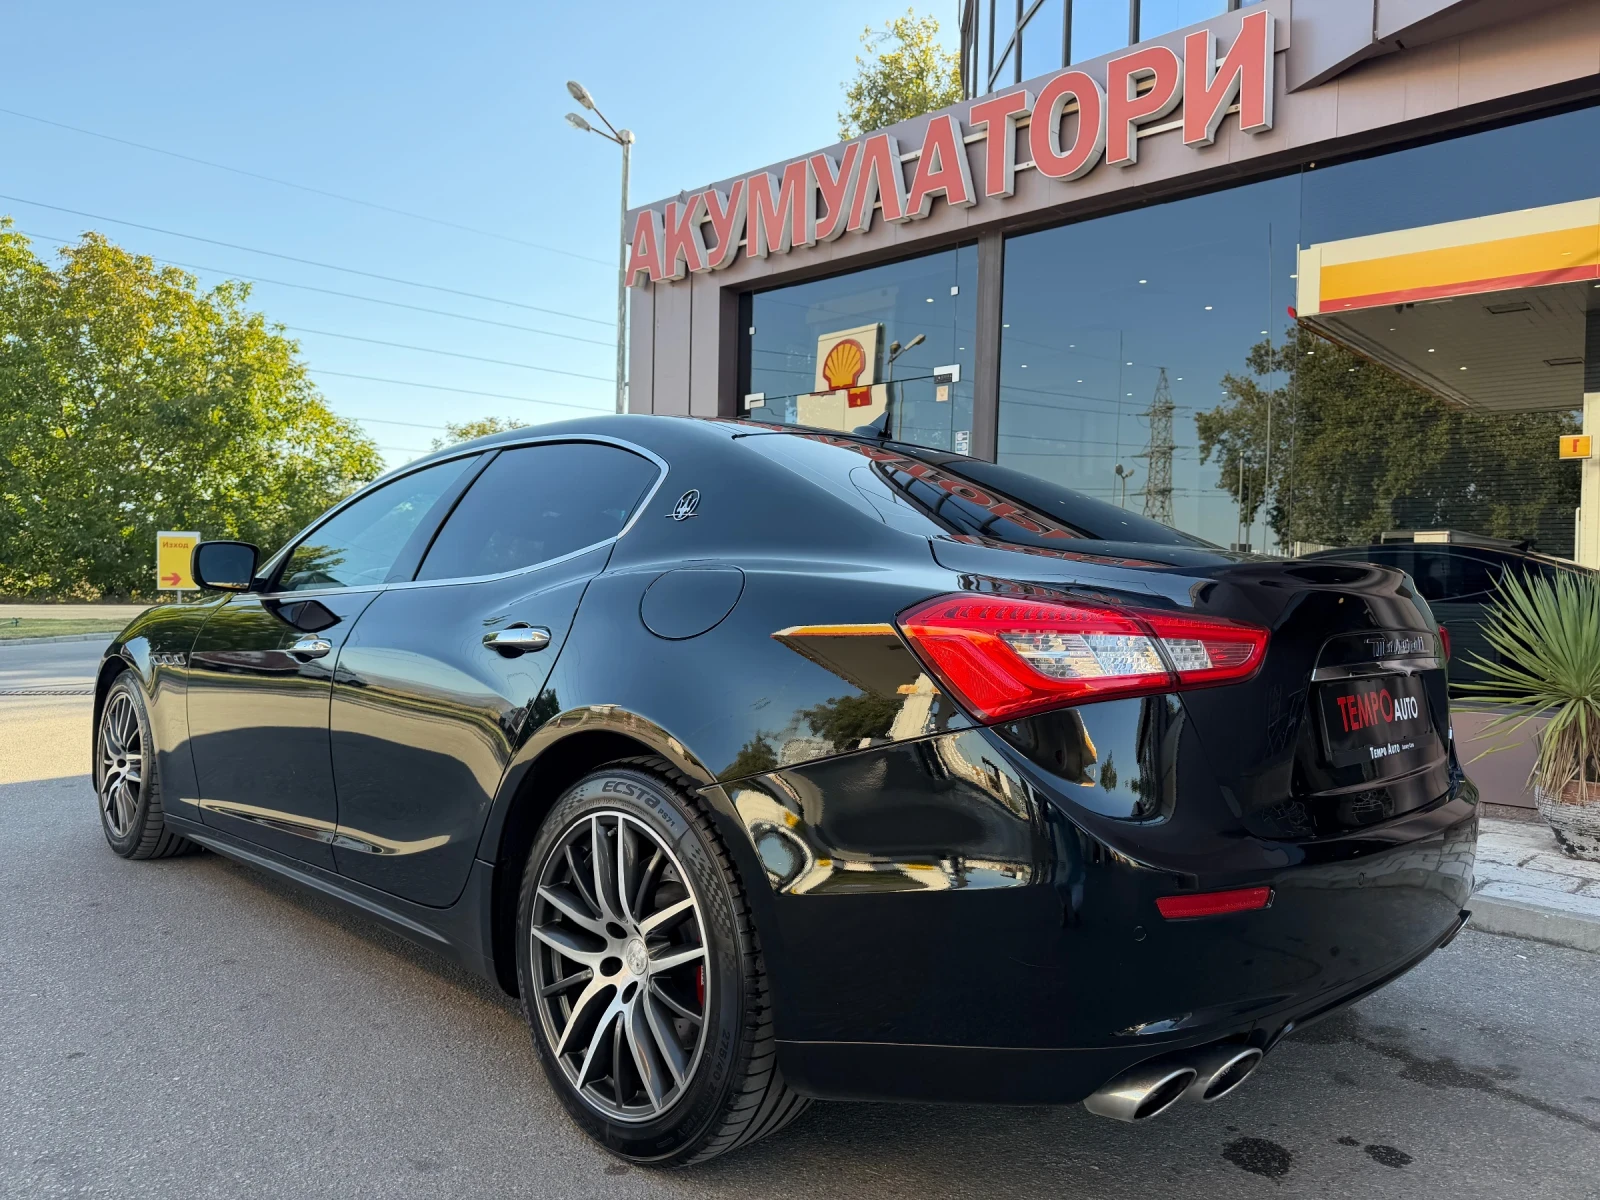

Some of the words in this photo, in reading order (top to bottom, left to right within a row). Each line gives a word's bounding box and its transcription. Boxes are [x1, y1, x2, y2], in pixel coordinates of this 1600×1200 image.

[624, 10, 1275, 288] АКУМУЛАТОРИ
[162, 541, 189, 549] Изход
[1337, 688, 1394, 733] TEMPO
[1394, 696, 1418, 721] AUTO
[657, 808, 676, 827] PS71
[712, 1029, 731, 1081] 275/40
